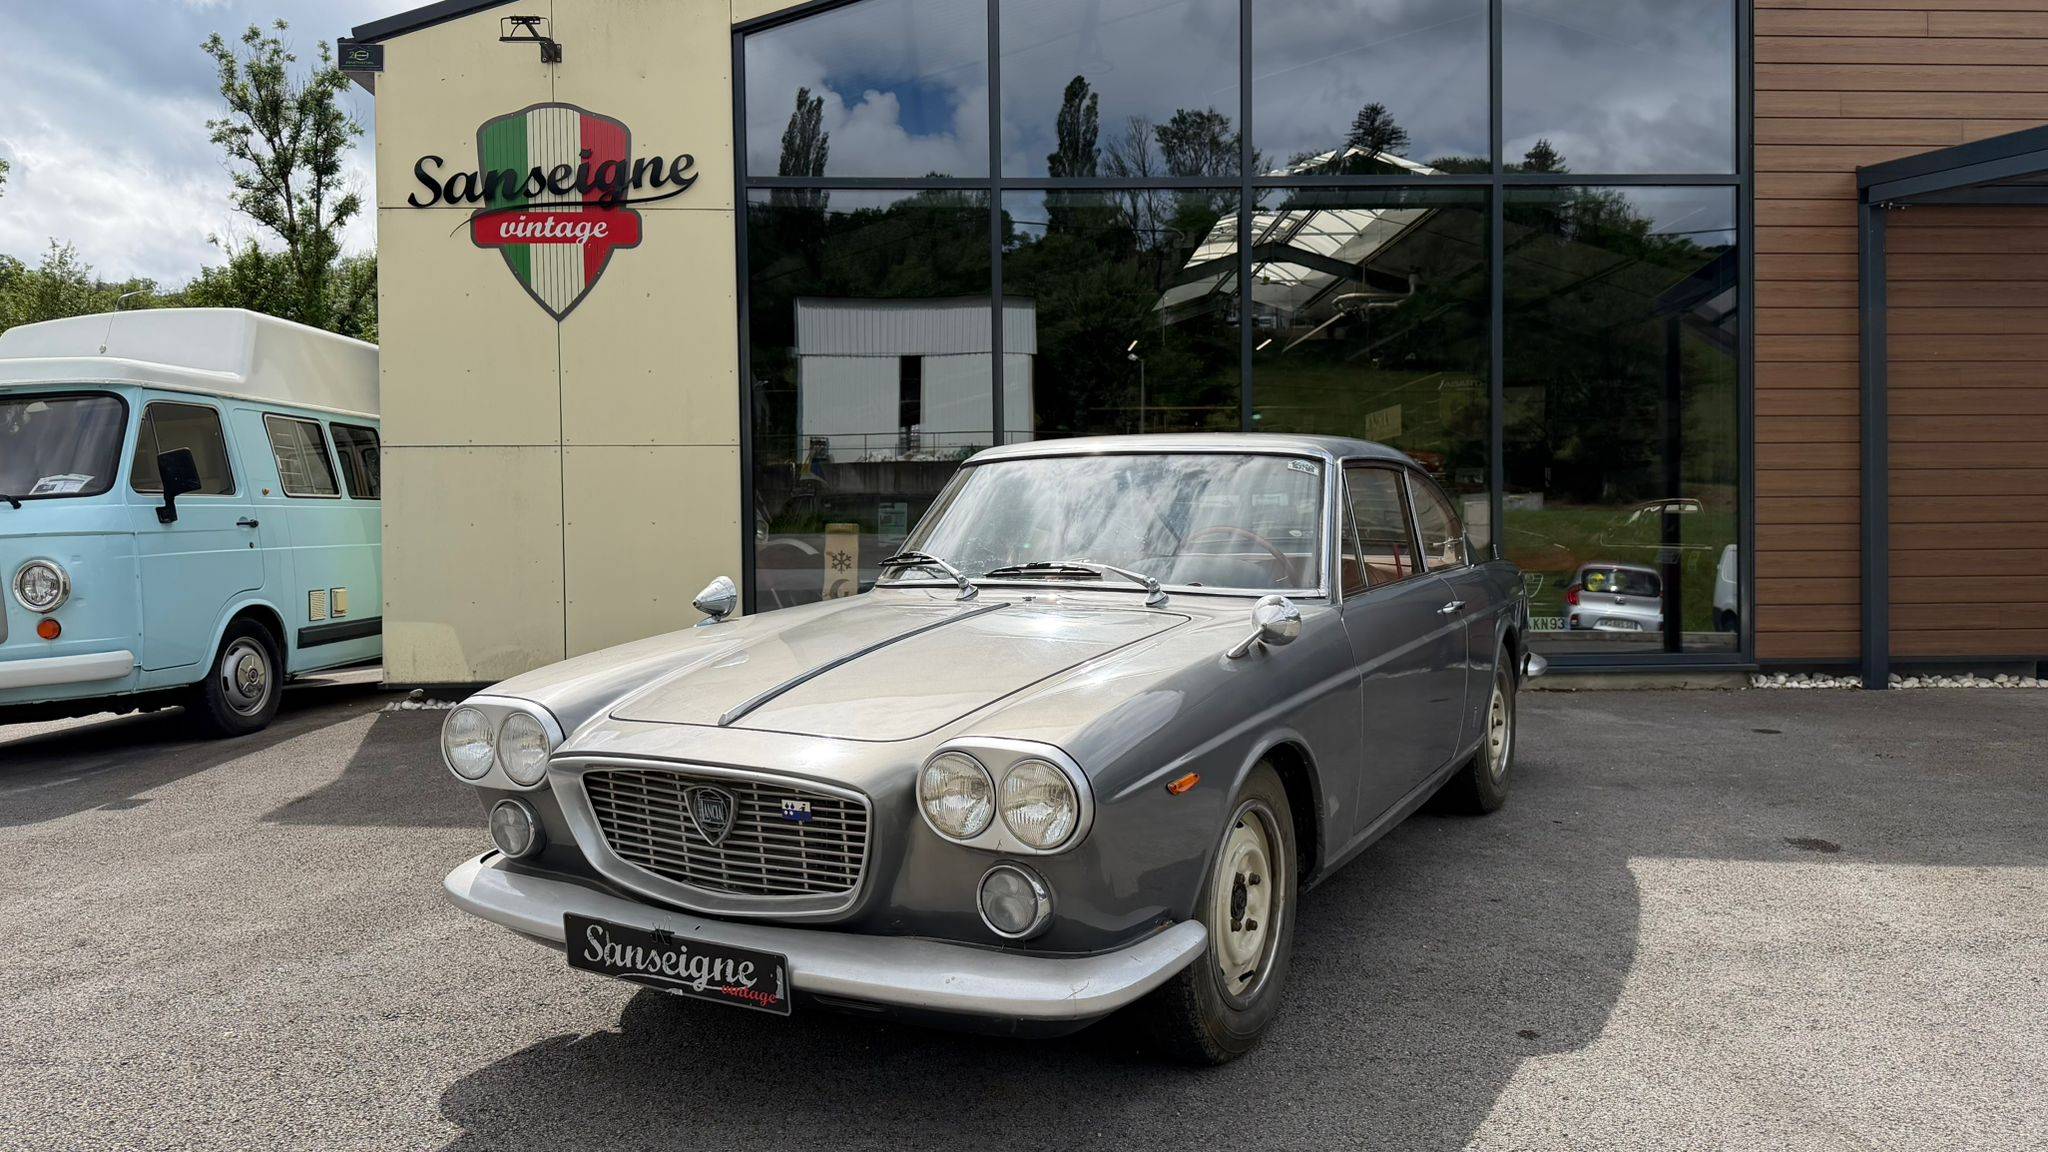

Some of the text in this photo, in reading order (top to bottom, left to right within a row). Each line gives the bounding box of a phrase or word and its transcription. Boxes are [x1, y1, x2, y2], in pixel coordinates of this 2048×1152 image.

[408, 149, 699, 211] Sanseigne
[500, 216, 608, 244] vintage
[584, 924, 757, 991] Sanseigne
[721, 983, 778, 1006] vintage
